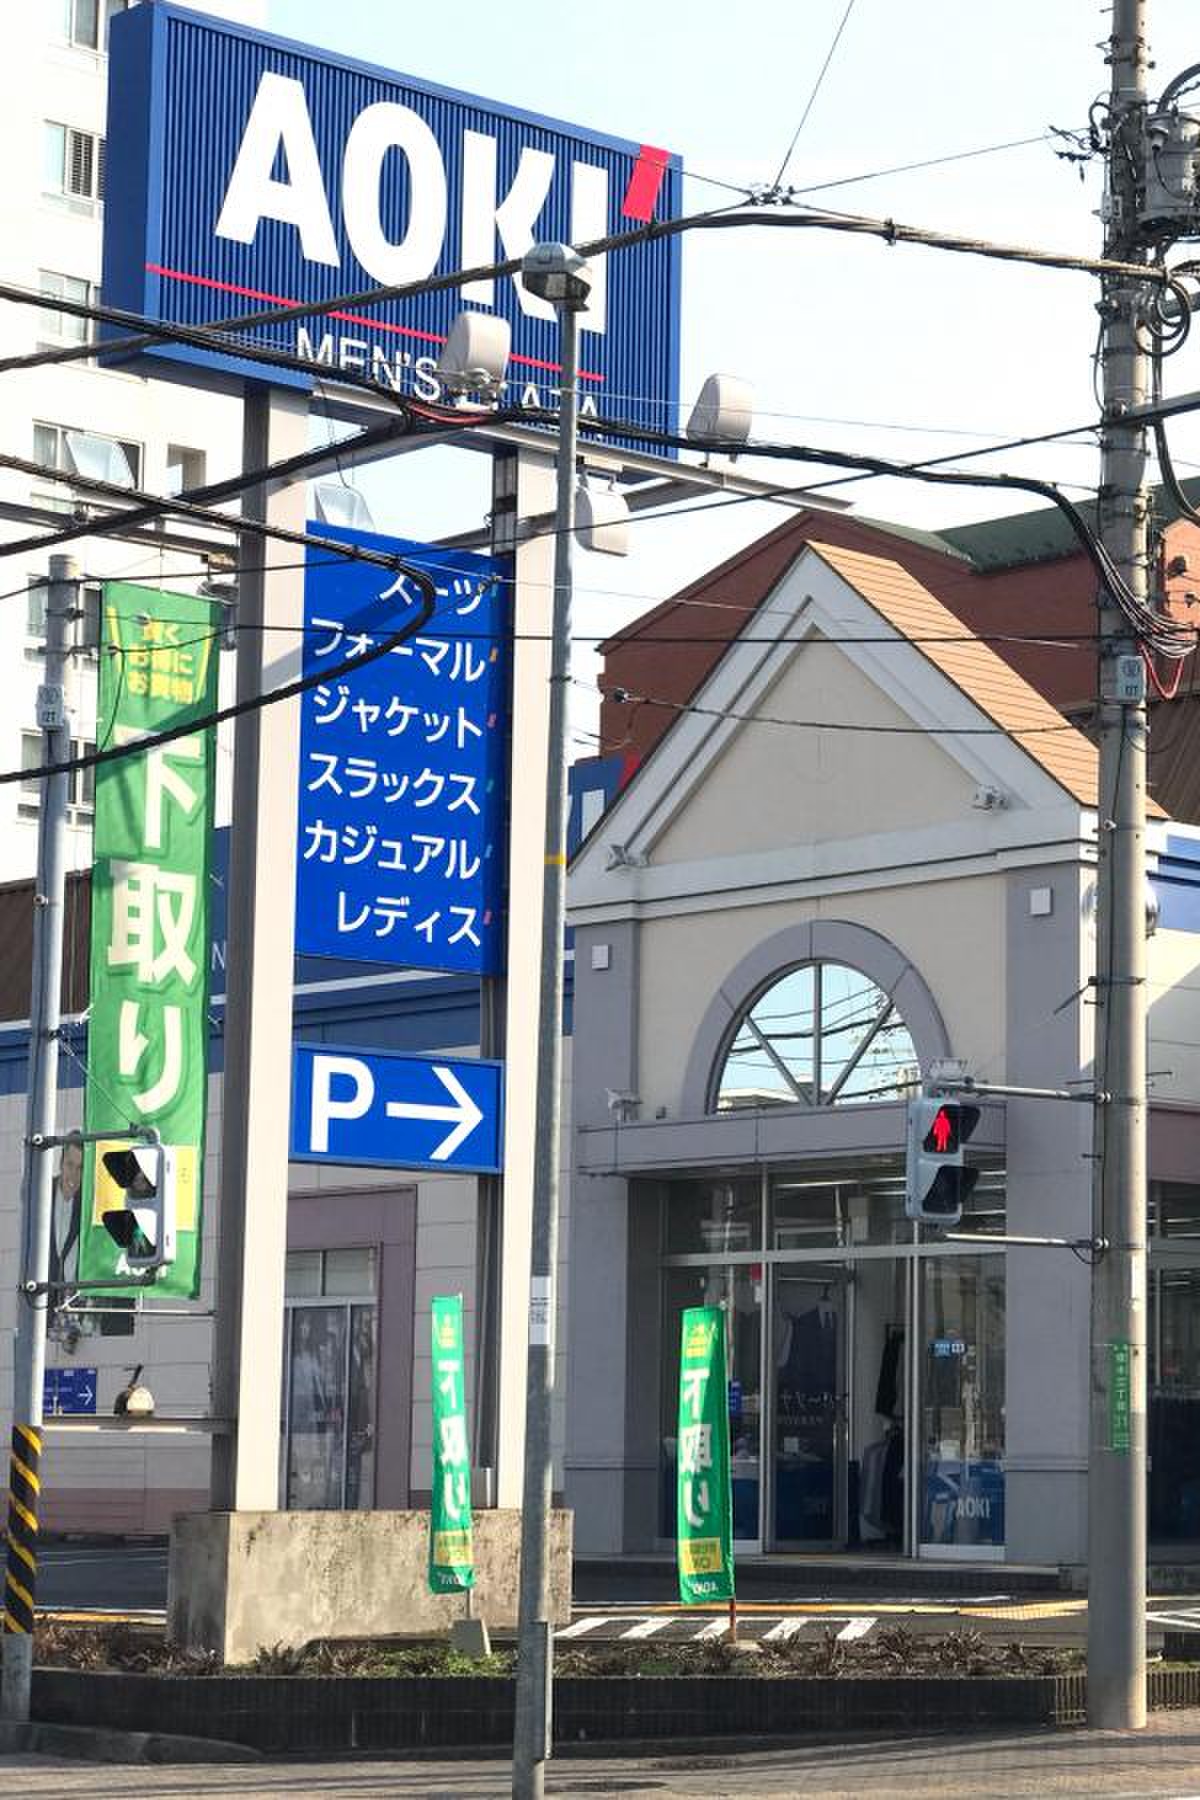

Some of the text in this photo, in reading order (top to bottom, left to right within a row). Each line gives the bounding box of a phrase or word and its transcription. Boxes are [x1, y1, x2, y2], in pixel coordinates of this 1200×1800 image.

[215, 70, 608, 335] AOKI
[311, 617, 486, 682] フォーマル
[313, 685, 483, 749] ジャケット
[307, 752, 481, 815] スラックス
[303, 819, 481, 880] カジュアル
[107, 724, 200, 1113] 下取り
[337, 891, 481, 947] レディス
[310, 1055, 375, 1152] P
